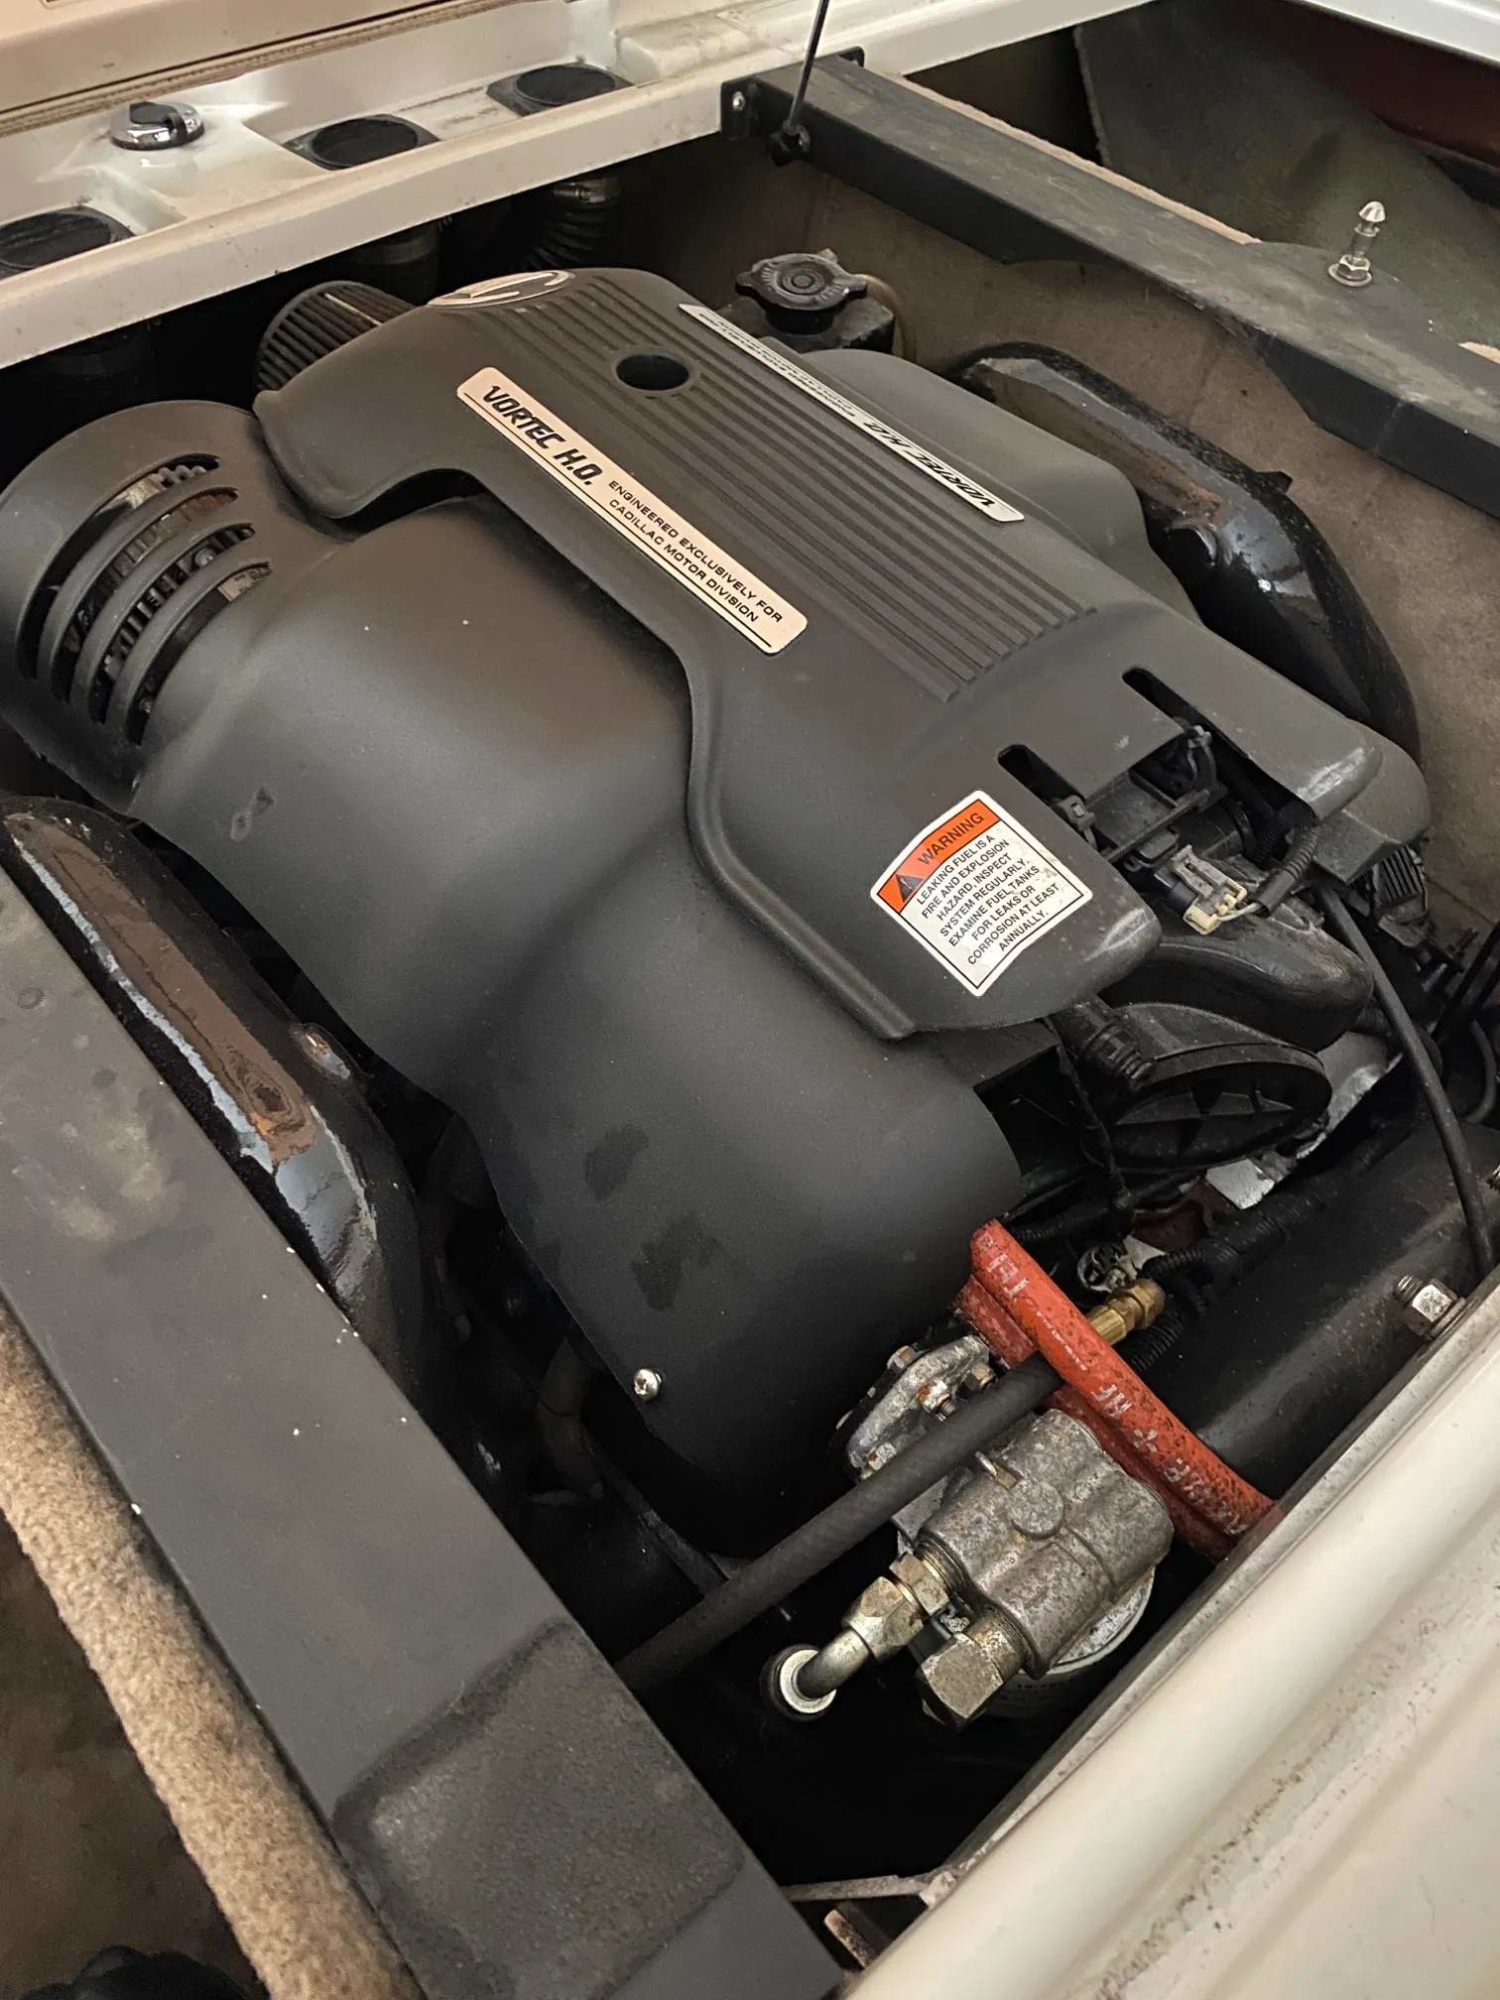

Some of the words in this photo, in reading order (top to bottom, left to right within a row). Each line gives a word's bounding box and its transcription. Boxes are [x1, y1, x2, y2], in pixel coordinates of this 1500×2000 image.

[483, 386, 566, 449] VORTEC
[553, 448, 603, 486] H.O.
[608, 480, 679, 539] ENGINEERED
[679, 538, 757, 600] EXCLUSIVELY
[756, 600, 783, 623] FOR
[609, 499, 665, 545] CADILLAC
[663, 544, 707, 580] MOTOR
[706, 579, 759, 622] DIVISION
[916, 864, 955, 905] LEAKING
[952, 848, 978, 867] FUEL
[975, 839, 987, 850] IS
[985, 834, 995, 844] A
[917, 812, 985, 865] WARNING
[973, 852, 1012, 884] INSPECT
[921, 896, 943, 919] FIRE
[940, 876, 960, 898] AND
[958, 839, 1010, 878] EXPLOSION
[940, 898, 976, 937] SYSTEM
[973, 858, 1030, 901] REGULARLY.
[948, 905, 988, 947] EXAMINE
[985, 888, 1012, 908] FUEL
[1007, 865, 1040, 890] TANKS
[971, 919, 993, 941] FOR
[990, 895, 1022, 921] LEAKS
[1020, 884, 1036, 898] OR
[967, 913, 1020, 965] CORROSION
[1018, 903, 1032, 917] AT
[1030, 882, 1060, 907] LEAST
[998, 909, 1049, 951] ANNUALLY.
